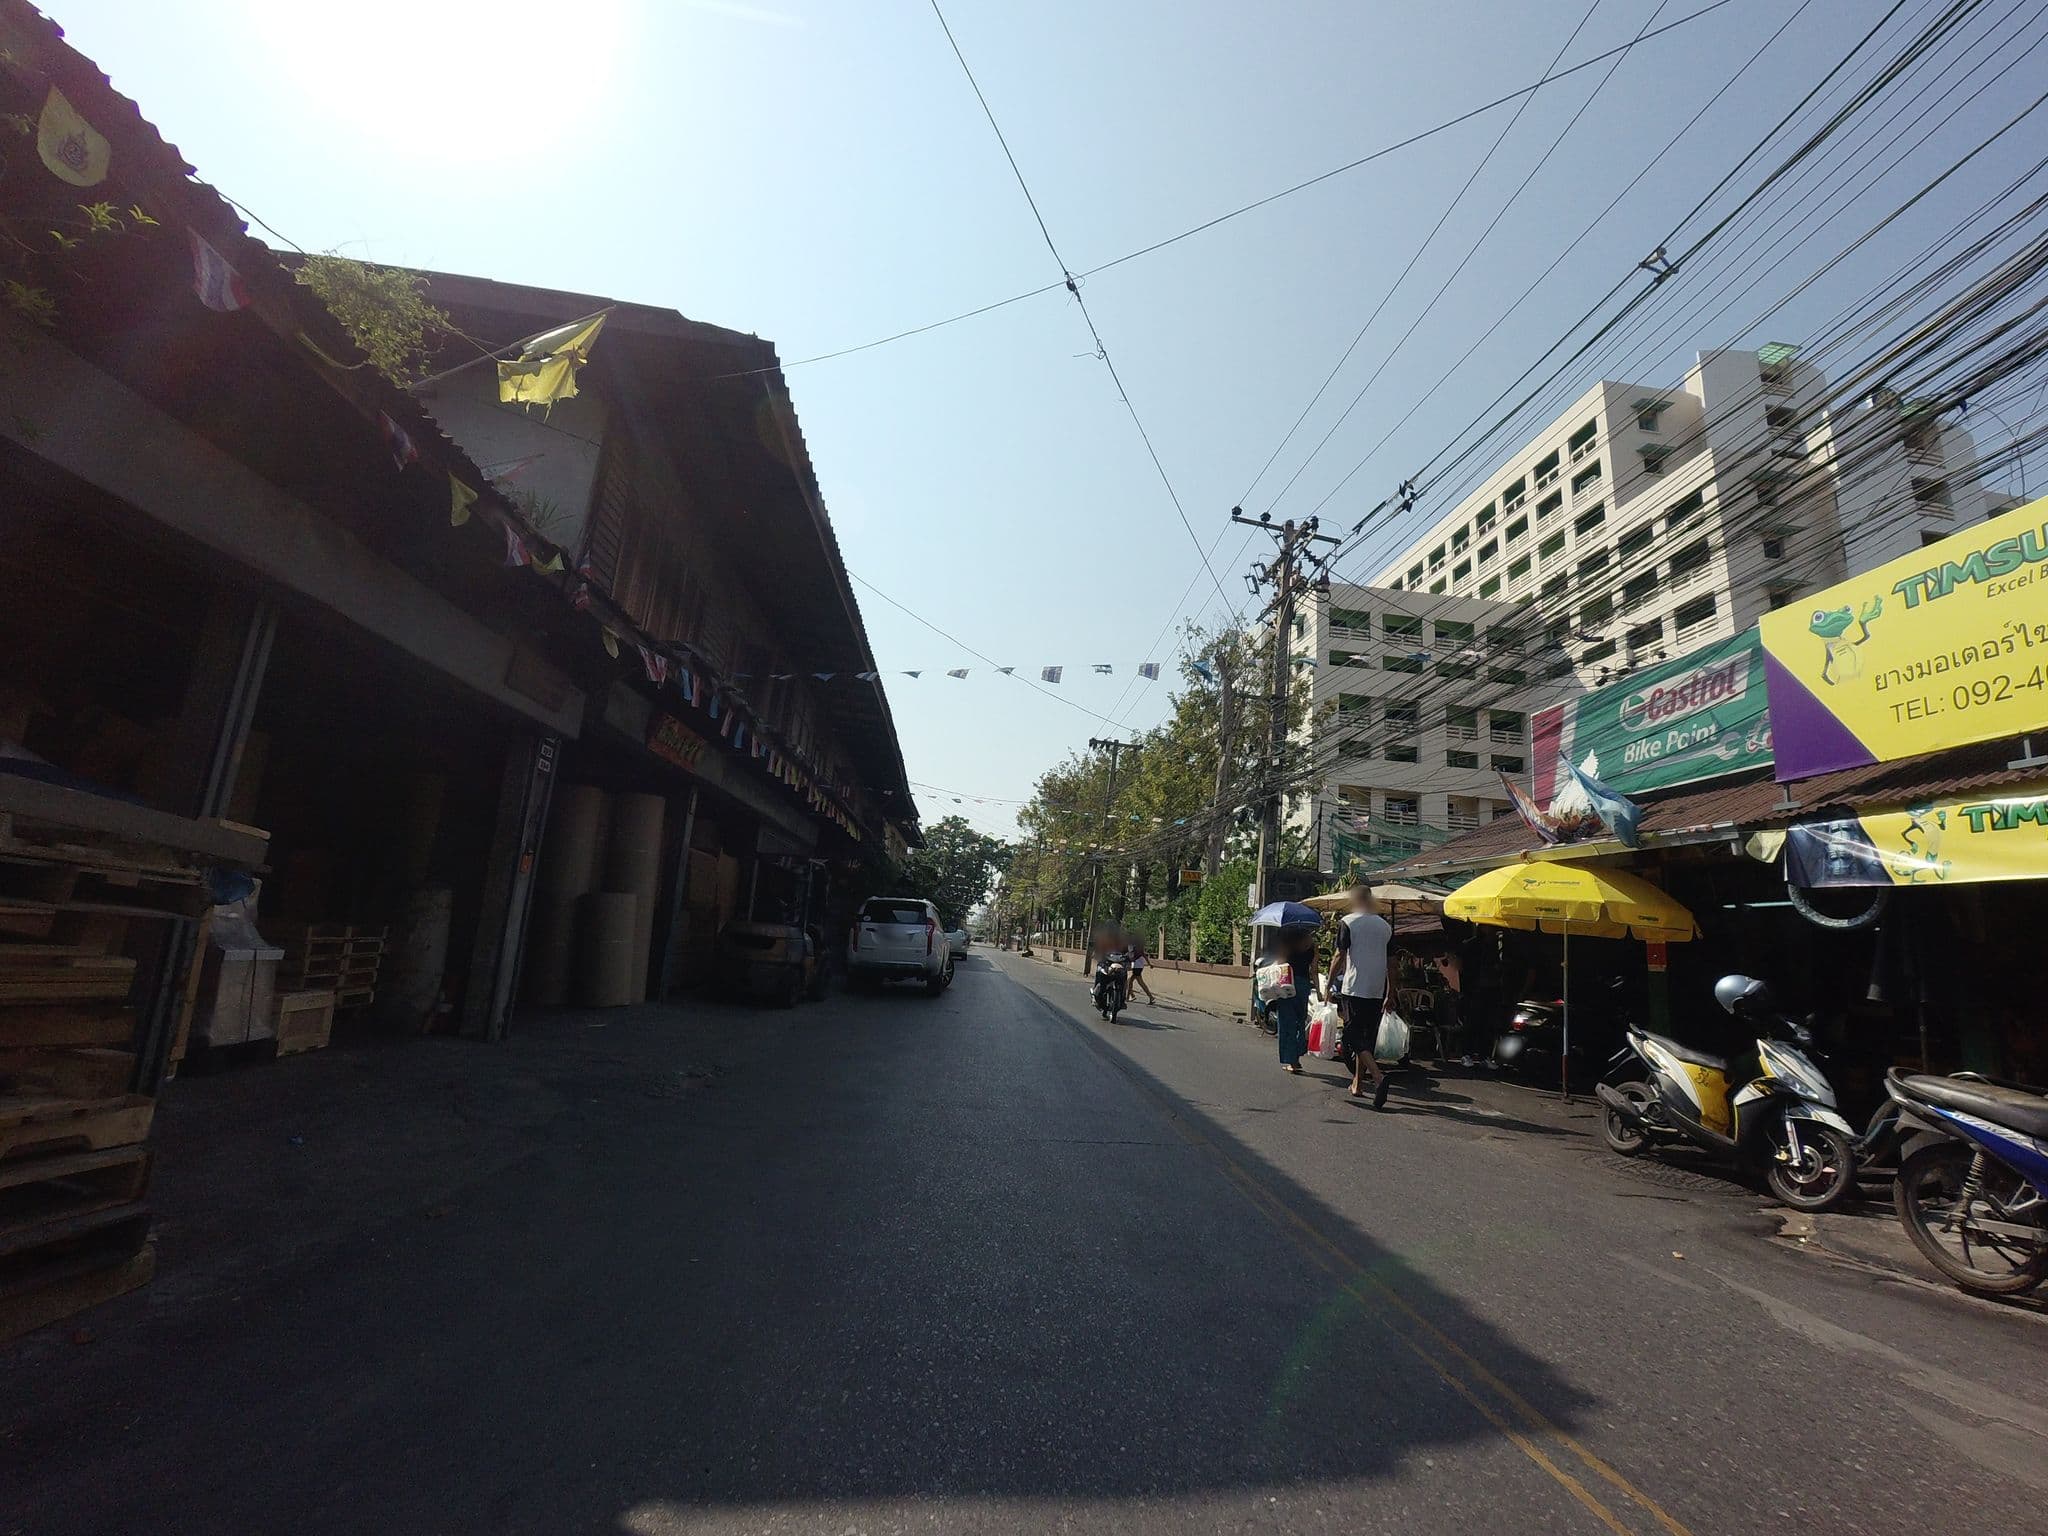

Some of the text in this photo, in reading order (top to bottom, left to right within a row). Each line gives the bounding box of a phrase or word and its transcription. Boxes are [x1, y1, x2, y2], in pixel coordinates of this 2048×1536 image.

[1986, 568, 2034, 598] Excel
[1647, 661, 1738, 721] Castrol
[1890, 664, 2048, 723] TEL: 092-4
[1624, 723, 1719, 764] Bike Point
